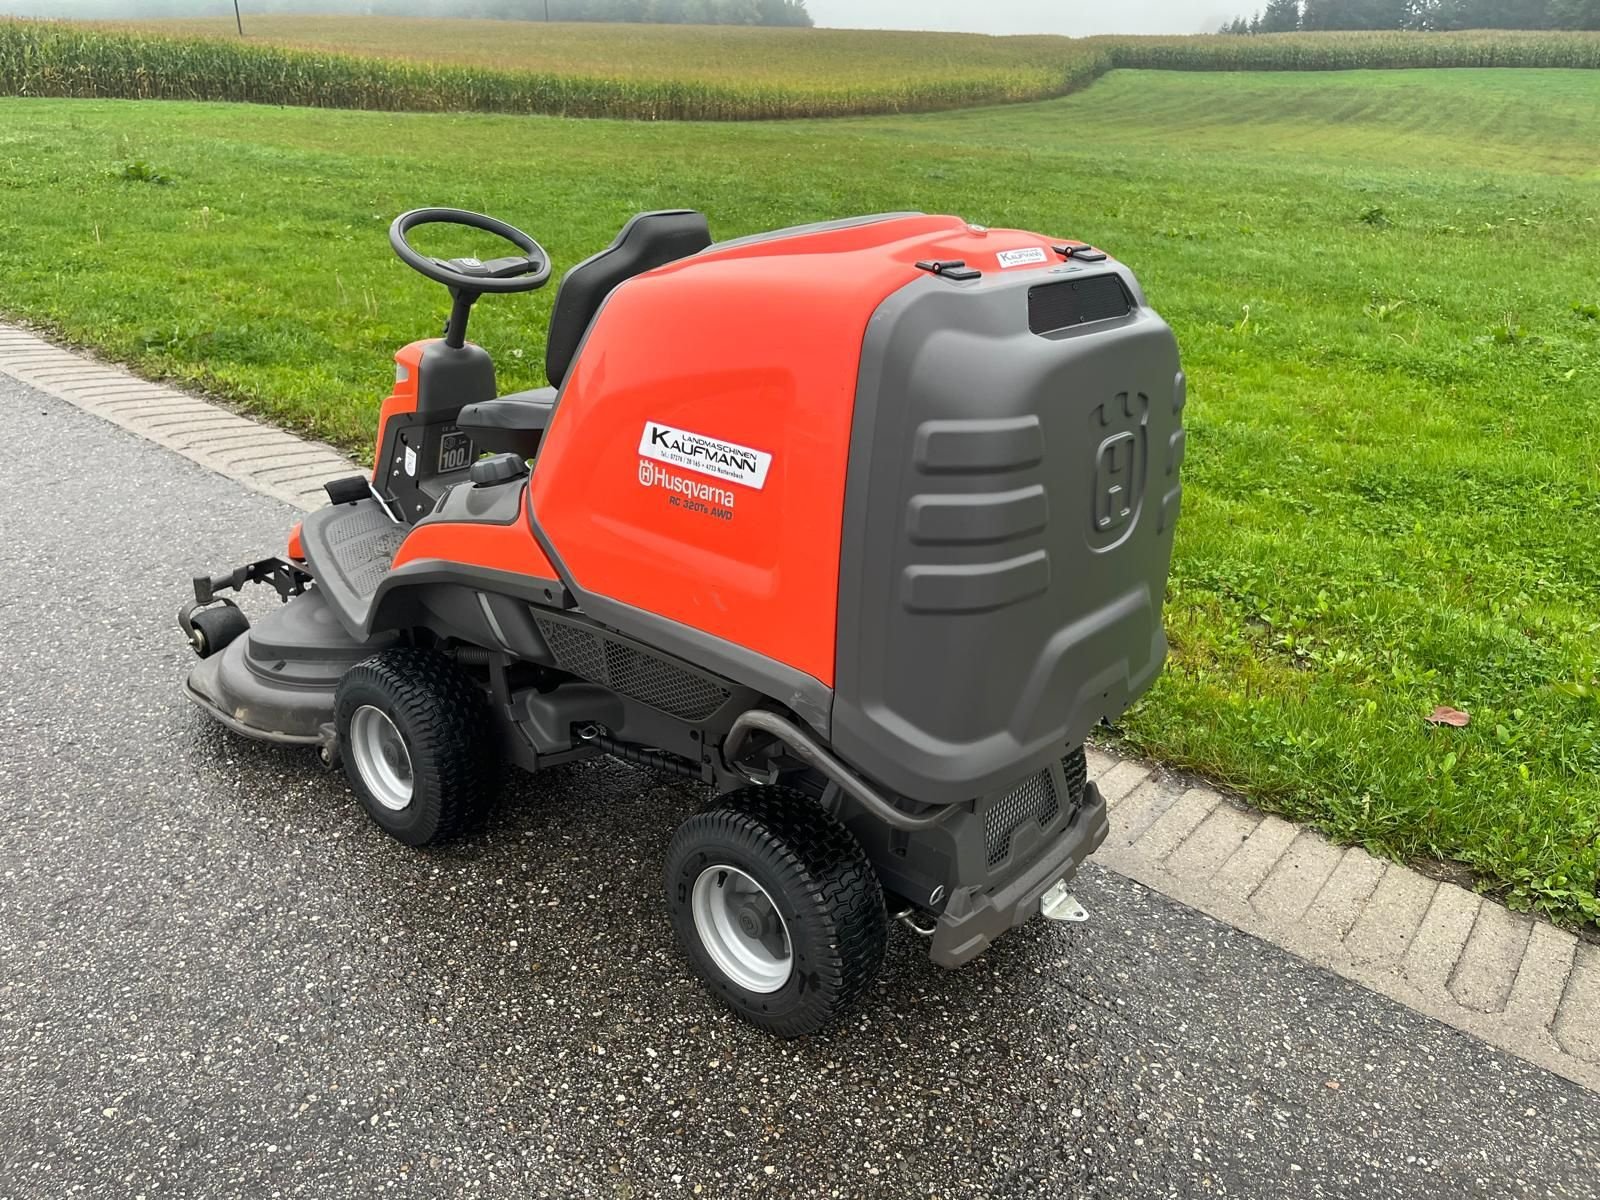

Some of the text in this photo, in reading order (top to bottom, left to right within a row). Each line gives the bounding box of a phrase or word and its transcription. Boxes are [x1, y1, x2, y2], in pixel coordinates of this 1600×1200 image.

[443, 448, 465, 468] 100
[652, 427, 756, 473] KAUFMANN
[682, 434, 757, 460] LANDMASCHINEN
[654, 466, 734, 508] Husqvarna
[669, 495, 733, 521] RC 320Ts AWD
